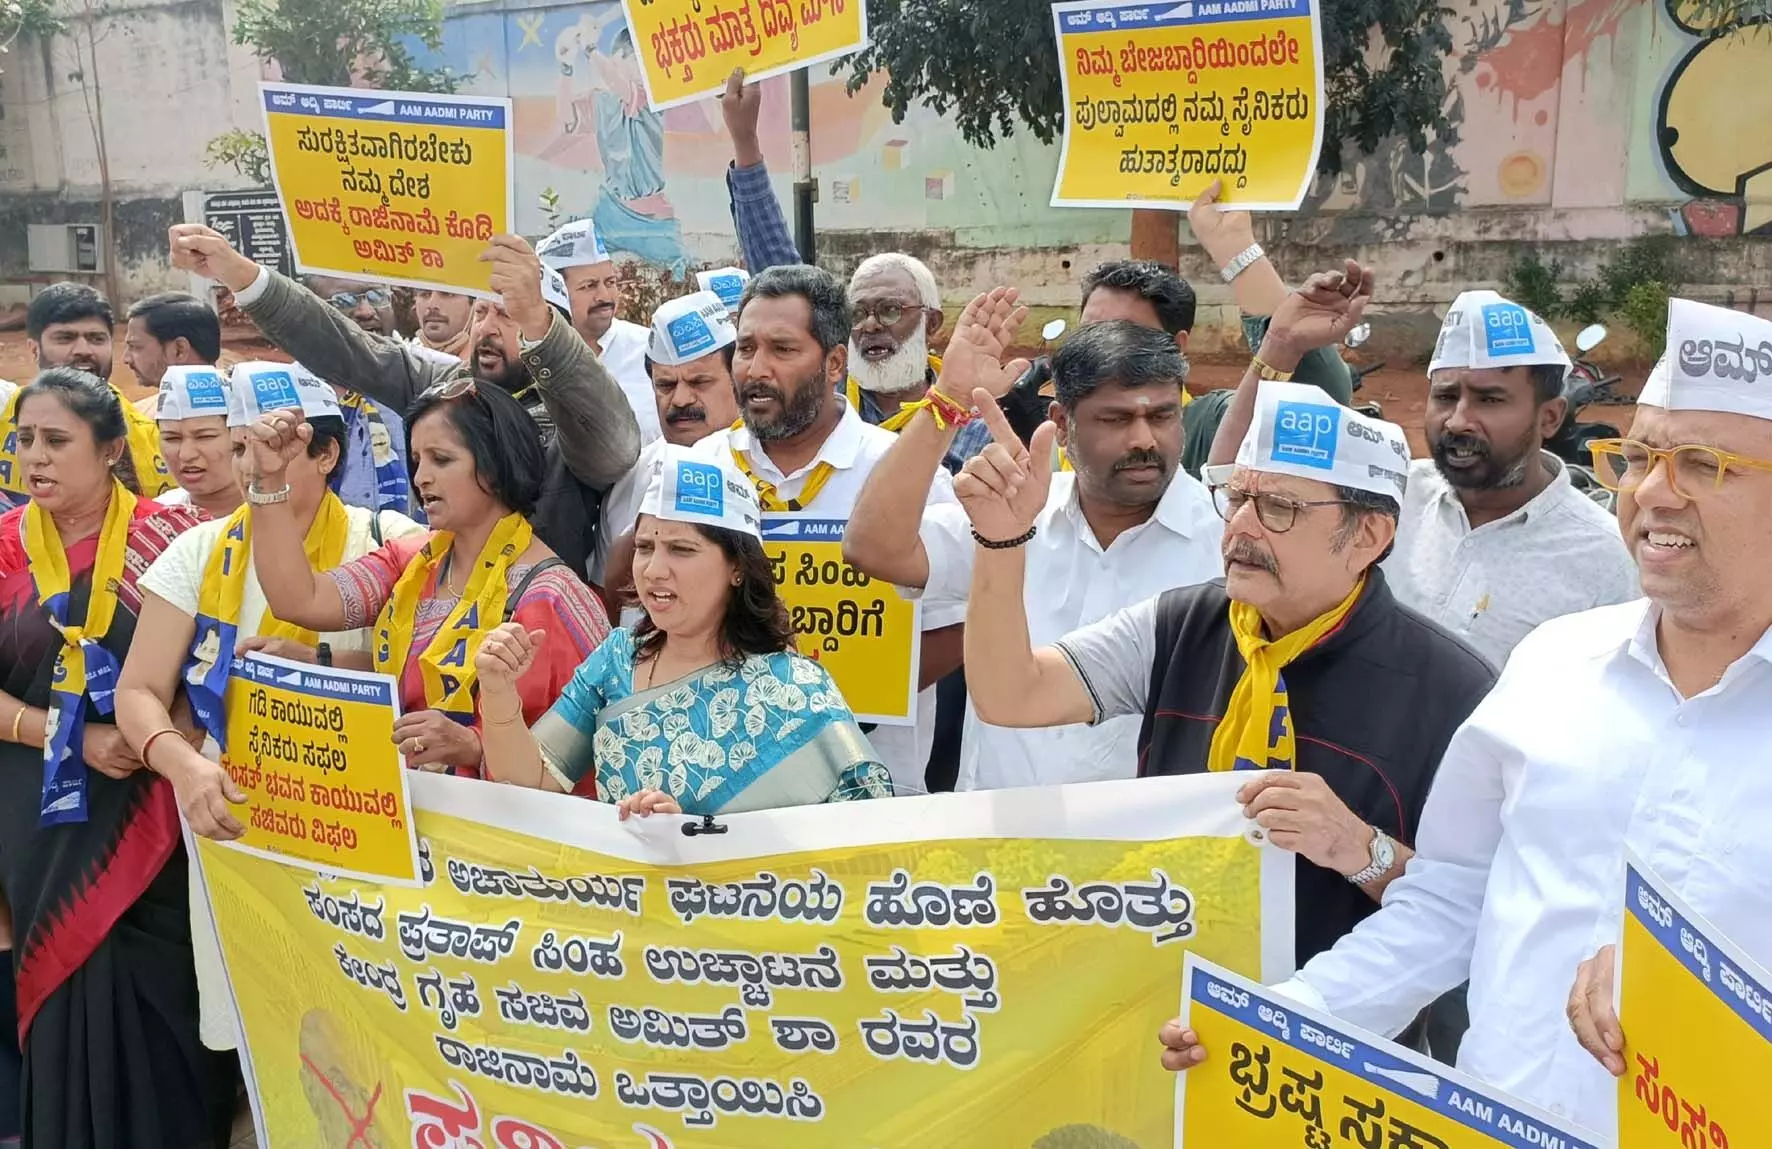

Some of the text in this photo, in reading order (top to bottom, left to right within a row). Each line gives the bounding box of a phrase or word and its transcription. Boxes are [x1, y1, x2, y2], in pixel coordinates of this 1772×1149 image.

[1198, 0, 1297, 16] AAM AADMI PARTY
[651, 14, 705, 83] ಭಕ್ತರು
[705, 5, 761, 56] ಮಾತ್ರ
[1076, 44, 1122, 87] ನಿಮ್ಮ
[400, 104, 494, 121] AAM AADMI PARTY
[1075, 86, 1308, 137] ಪುಲ್ವಾಮದಲ್ಲಿ ನಮ್ಮ ಸೈನಿಕರು
[296, 125, 472, 165] ಸುರಕ್ಷಿತವಾಗಿರಬೇಕು
[1119, 142, 1248, 188] ಹುತಾತ್ಮರಾದದ್ದು
[341, 166, 431, 206] ನಮ್ಮ ದೇಶ
[295, 197, 350, 235] ಅದಕ್ಕೆ
[445, 210, 493, 241] ಕೊಡಿ
[353, 239, 444, 269] ಅಮಿತ್ ಶಾ
[1489, 311, 1524, 339] aap
[256, 377, 290, 402] aap
[1281, 410, 1332, 449] aap
[681, 468, 720, 499] aap
[804, 523, 828, 535] AAM
[791, 598, 885, 652] ಬ್ದಾರಿಗೆ
[304, 676, 382, 697] AAM AADMI PARTY
[248, 688, 349, 744] ಗಡಿ ಕಾಯುವಲ್ಲಿ
[248, 725, 347, 775] ಸೈನಿಕರು ಸಫಲ
[265, 770, 306, 802] ಭವನ
[310, 782, 403, 829] ಕಾಯುವಲ್ಲಿ
[250, 804, 358, 852] ಸಚಿವರು ವಿಫಲ
[449, 860, 644, 912] ಅಚಾತುರ್ಯ
[668, 869, 842, 922] ಘಟನೆಯ
[866, 872, 997, 926] ಹೊಣೆ
[1024, 871, 1193, 943] ಹೊತ್ತು
[304, 887, 998, 1009] ಸಂಸದ ಪ್ರತಾಪ್ ಸಿಂಹ ಉಚ್ಚಾಟನೆ ಮತ್ತು
[1638, 884, 1673, 928] ಆಮ್
[1680, 927, 1711, 983] ಆದ್ಮಿ
[334, 944, 978, 1066] ಕೇಂದ್ರ ಗೃಹ ಸಚಿವ ಅಮಿತ್ ಶಾ ರವರ
[1207, 980, 1355, 1060] ಆಮ್ ಆದ್ಮಿ ಪಾರ್ಟಿ
[616, 1073, 822, 1125] ಒತ್ತಾಯಿಸಿ
[1229, 1042, 1332, 1149] ಭ್ರಷ್ಟ
[1448, 1091, 1493, 1123] AAM
